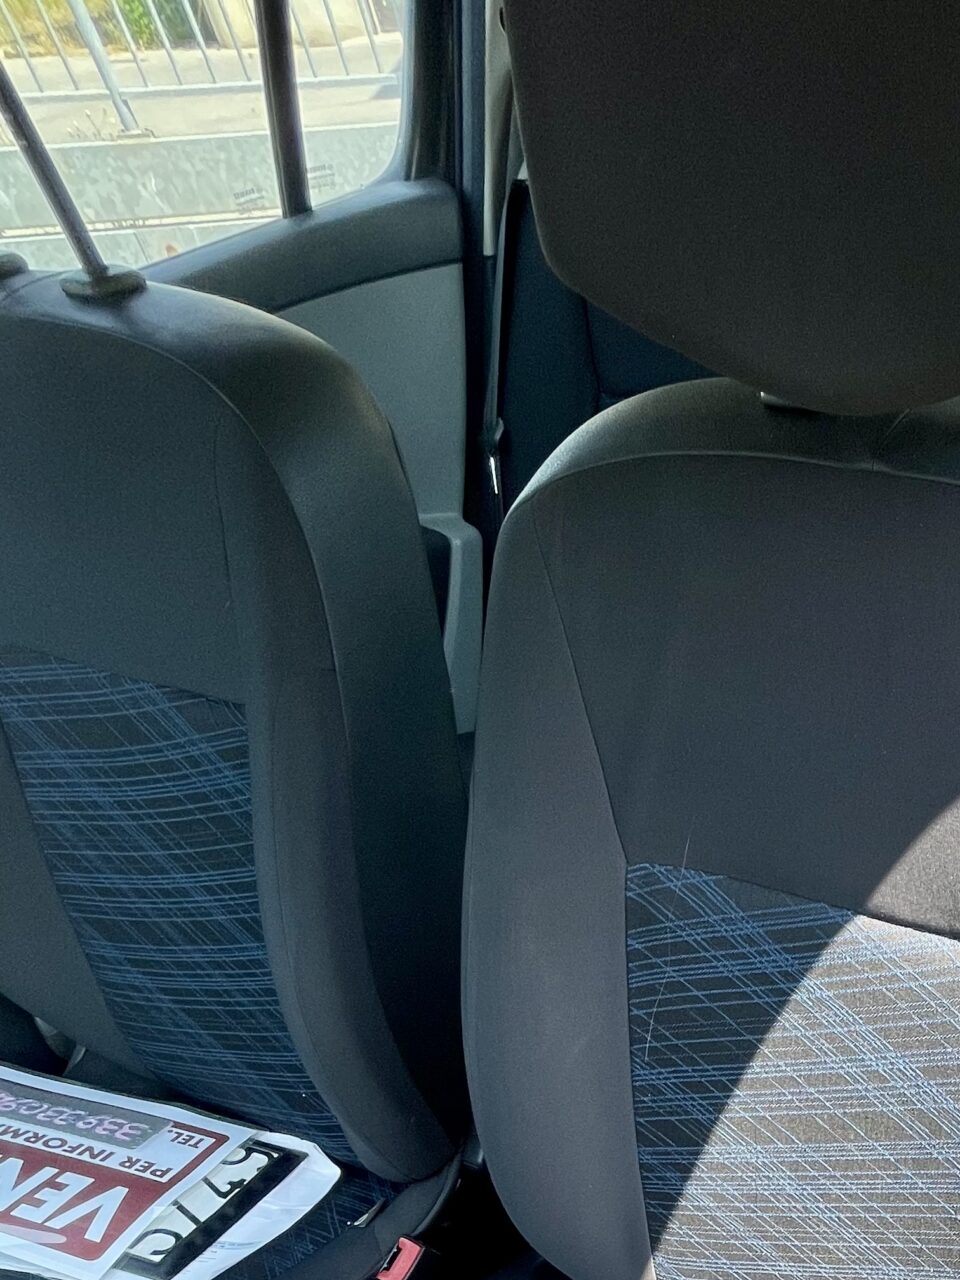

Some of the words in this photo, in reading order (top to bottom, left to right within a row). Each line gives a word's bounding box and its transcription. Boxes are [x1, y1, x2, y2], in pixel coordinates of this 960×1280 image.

[0, 1123, 116, 1162] INFORM
[167, 1129, 205, 1149] TEL.
[118, 1155, 173, 1179] PER
[0, 1154, 129, 1243] VEN
